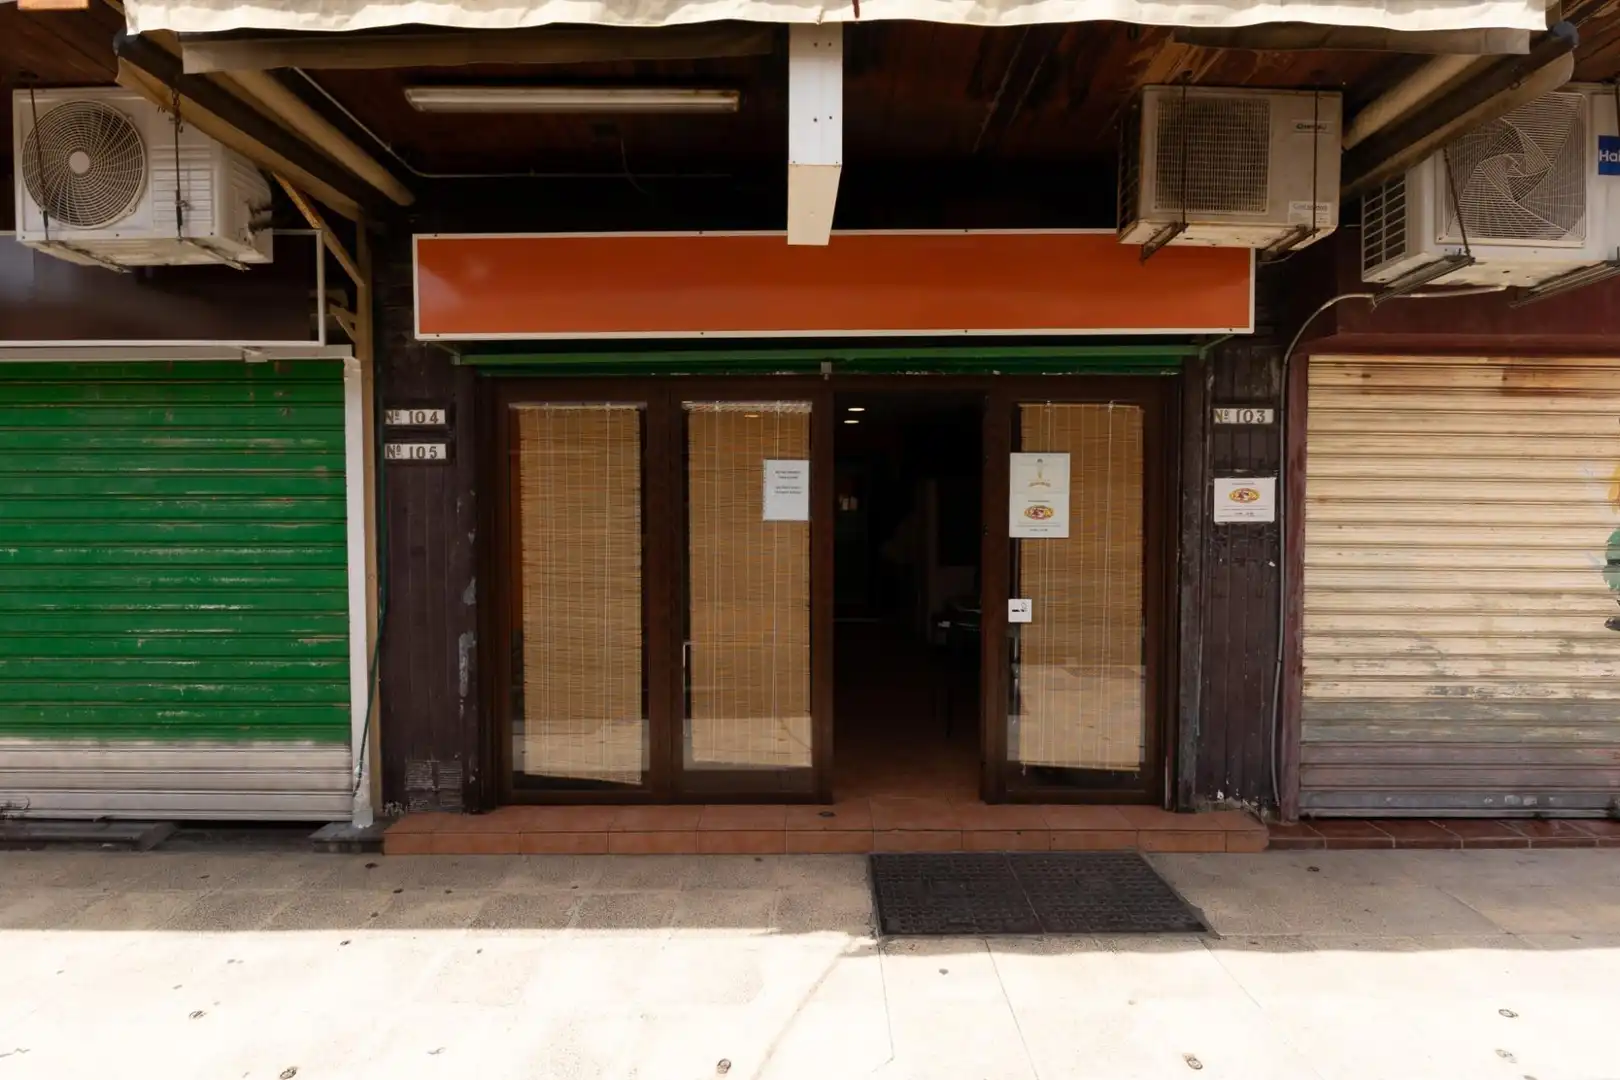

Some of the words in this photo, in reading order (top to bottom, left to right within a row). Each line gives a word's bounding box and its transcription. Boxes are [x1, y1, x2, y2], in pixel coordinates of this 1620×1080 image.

[409, 410, 439, 424] 104
[1236, 409, 1266, 423] 103
[409, 446, 438, 459] 105
